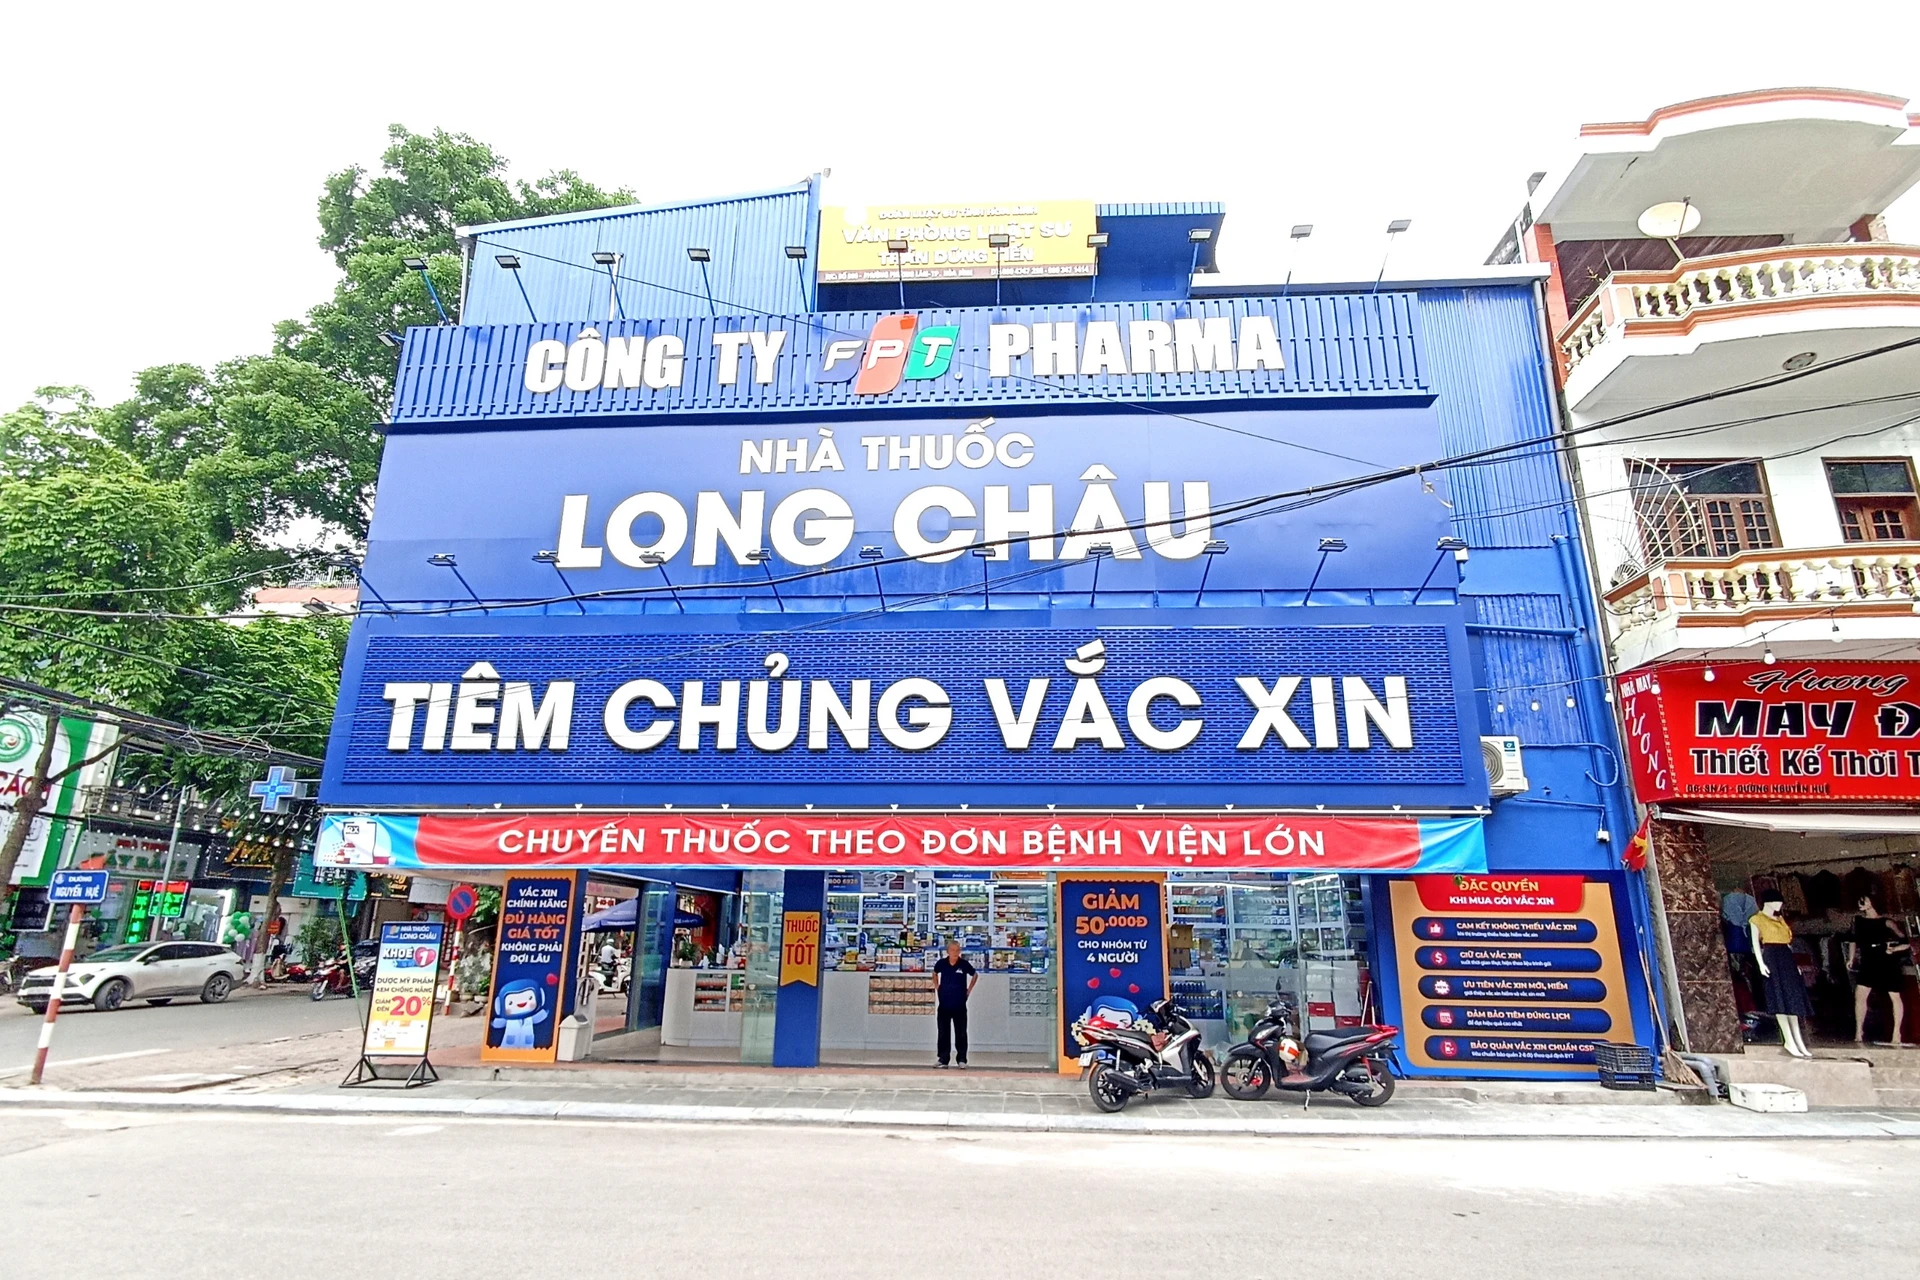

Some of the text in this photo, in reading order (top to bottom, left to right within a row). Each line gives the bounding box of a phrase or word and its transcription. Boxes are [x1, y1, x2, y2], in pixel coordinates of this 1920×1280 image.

[841, 225, 890, 244] VĂN
[895, 222, 971, 242] PHÒNG
[1039, 219, 1073, 239] SƯ
[877, 242, 1034, 267] TRẦN DŨNG TIẾN
[524, 327, 684, 394] CÔNG
[712, 331, 787, 385] TY
[989, 315, 1286, 379] PHARMA
[739, 416, 1035, 475] NHÀ THUỐC
[556, 463, 1213, 569] LONG CHÂU
[1620, 673, 1652, 699] NHÀ MAY
[383, 637, 1414, 752] TIÊM CHỦNG VẮC XIN
[1695, 698, 1857, 738] MAY
[1690, 744, 1770, 776] Thiết
[1780, 744, 1827, 776] Kế
[1829, 748, 1899, 777] Thời
[499, 819, 1325, 863] CHUYÊN THUỐC THEO ĐƠN BỆNH VIỆN LỚN
[68, 875, 93, 883] ĐƯỜNG
[1459, 878, 1539, 894] ĐẶC QUYỀN
[55, 884, 83, 897] NGUYỄN
[519, 885, 558, 898] VẮC XIN
[507, 897, 568, 909] CHÍNH HÃNG
[1082, 888, 1140, 910] GIẢM
[1449, 894, 1555, 906] KHI MUA GÓI VẮC XIN
[504, 910, 566, 926] ĐỦ HÀNG
[785, 914, 819, 933] THUỐC
[507, 925, 560, 940] GIÁ TỐT
[1456, 922, 1475, 930] CAM
[1475, 921, 1490, 930] KẾT
[1491, 922, 1520, 931] KHÔNG
[1520, 922, 1544, 931] THIẾU
[1545, 922, 1562, 931] VẮC
[501, 941, 563, 953] KHÔNG PHẢI
[784, 935, 816, 966] TỐT
[1077, 938, 1148, 950] CHO NHÓM TỪ
[420, 950, 429, 966] 1
[510, 953, 551, 964] ĐỢI LÂU
[1086, 952, 1139, 963] 4 NGƯỜI
[1475, 950, 1489, 959] GIÁ
[1490, 950, 1507, 960] VẮC
[399, 976, 411, 984] MỸ
[1463, 980, 1475, 988] ƯU
[1475, 980, 1494, 988] TIÊN
[1495, 980, 1513, 989] VẮC
[1547, 981, 1568, 990] HIẾM
[1467, 1009, 1571, 1021] ĐẢM BẢO TIÊM ĐÚNG LỊCH
[1470, 1040, 1595, 1052] BẢO QUẢN VẮC XIN CHUẨN GSP
